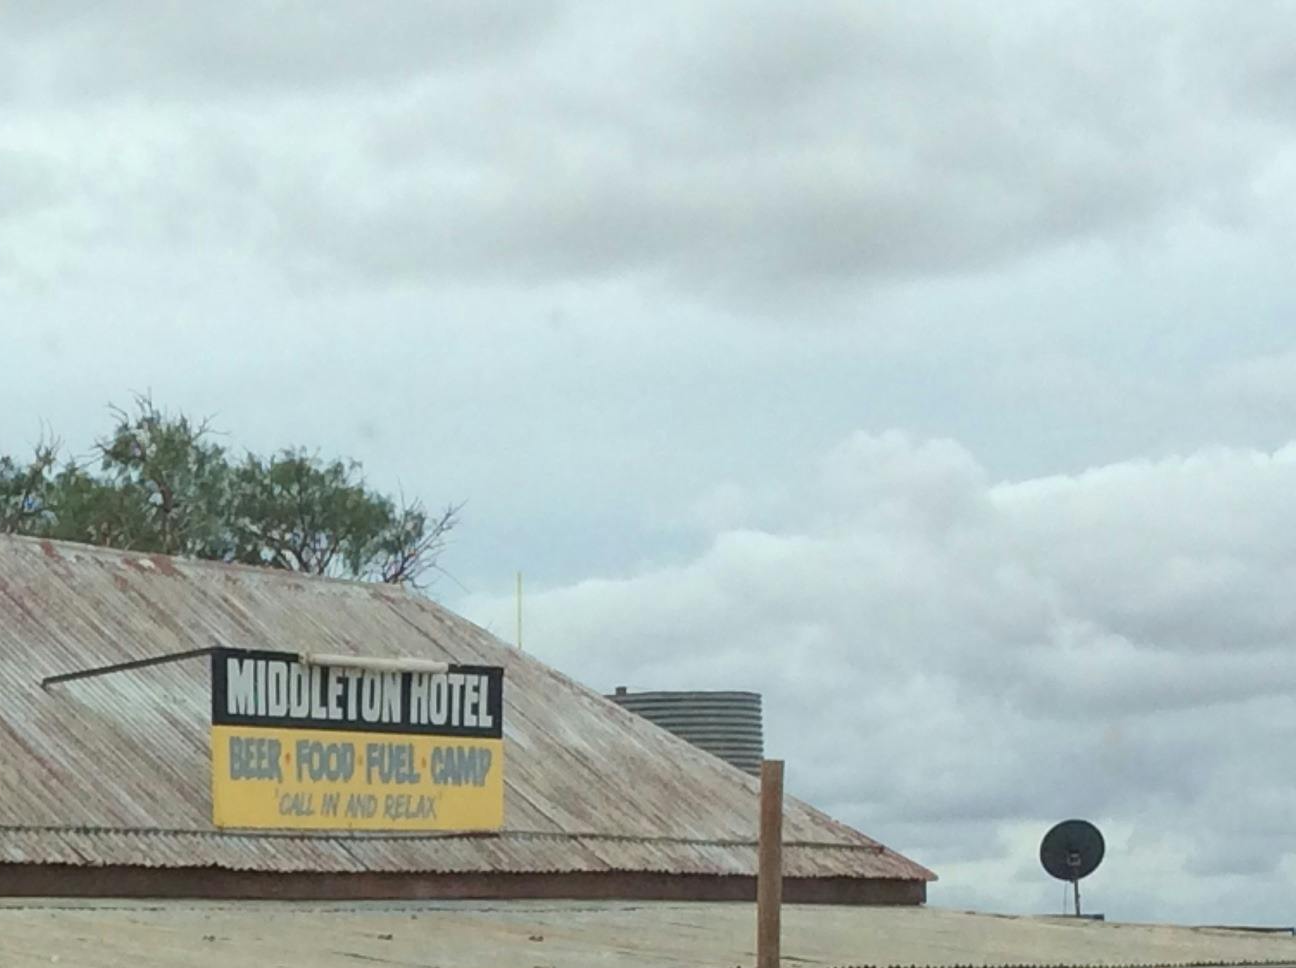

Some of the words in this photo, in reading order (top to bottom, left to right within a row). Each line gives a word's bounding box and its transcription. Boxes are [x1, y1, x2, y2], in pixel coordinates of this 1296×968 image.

[227, 658, 401, 724] MIDDLETON
[410, 670, 493, 728] HOTEL
[229, 736, 282, 784] BEER
[295, 739, 354, 783] FOOD
[366, 742, 421, 785] FUEL
[431, 746, 493, 787] CAMP
[320, 793, 340, 817] IN
[344, 793, 378, 819] AND
